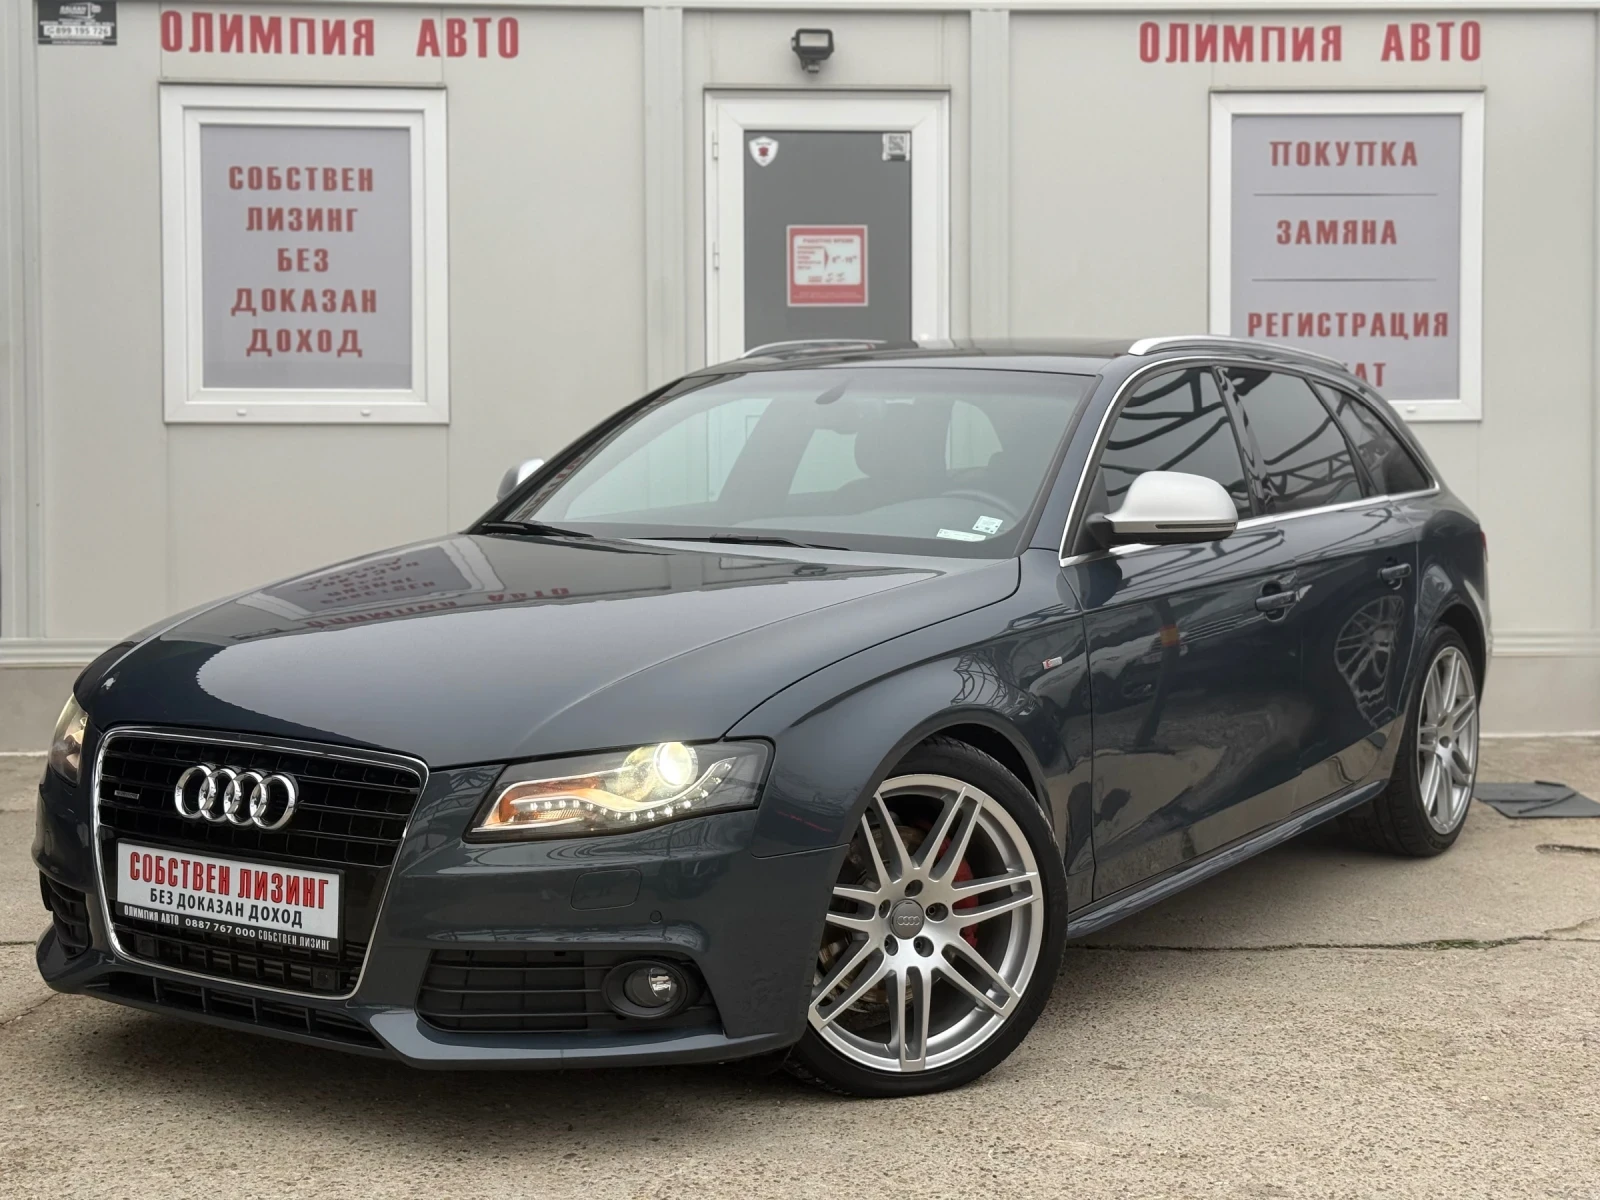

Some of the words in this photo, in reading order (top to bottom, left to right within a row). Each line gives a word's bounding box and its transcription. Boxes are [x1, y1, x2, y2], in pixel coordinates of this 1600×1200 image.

[160, 10, 375, 56] ОЛИМПИЯ
[416, 16, 520, 59] АВТО
[1139, 22, 1342, 63] ОЛИМПИЯ
[1381, 20, 1481, 62] АВТО
[1269, 140, 1418, 167] ПОКУПКА
[228, 165, 374, 192] СОБСТВЕН
[246, 207, 359, 232] ЛИЗИНГ
[1276, 219, 1398, 245] ЗАМЯНА
[277, 248, 329, 273] БЕЗ
[231, 288, 377, 316] ДОКАЗАН
[1247, 311, 1448, 339] РЕГИСТРАЦИЯ
[246, 329, 363, 357] ДОХОД
[1342, 361, 1387, 387] АТ
[129, 851, 230, 896] СОБСТВЕН
[237, 868, 329, 910] ЛИЗИНГ
[150, 888, 174, 905] БЕЗ
[176, 892, 244, 918] ДОКАЗАН
[248, 904, 303, 929] ДОХОД
[123, 904, 159, 923] ОЛИМПИЯ
[161, 911, 179, 926] АВТО
[185, 918, 211, 930] 0887
[213, 922, 232, 934] 767
[235, 926, 256, 938] 000
[258, 929, 297, 945] СОБСТВЕН
[299, 936, 331, 951] ЛИЗИНГ
